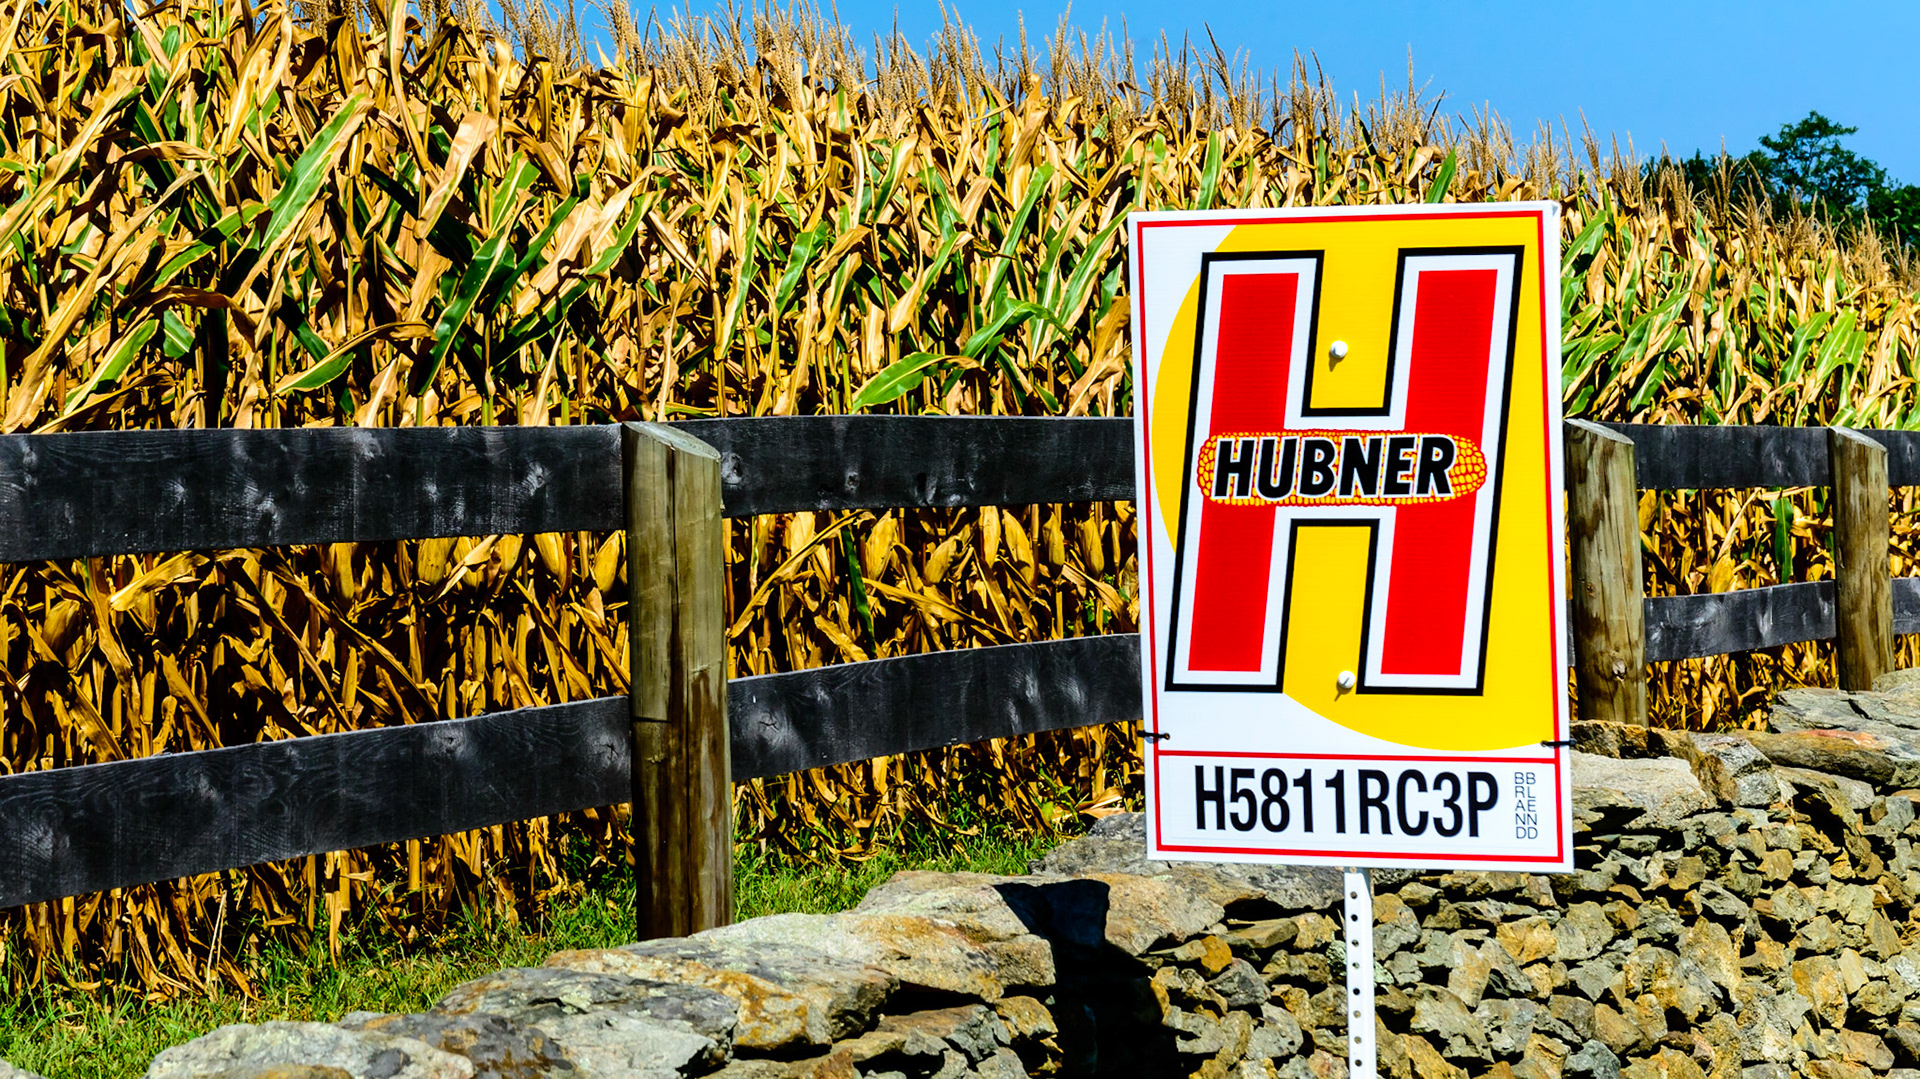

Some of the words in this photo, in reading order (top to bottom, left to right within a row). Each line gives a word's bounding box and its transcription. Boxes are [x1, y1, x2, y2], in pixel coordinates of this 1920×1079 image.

[1164, 245, 1525, 697] H
[1213, 433, 1457, 500] HUBNER
[1195, 765, 1499, 838] H5811RC3P
